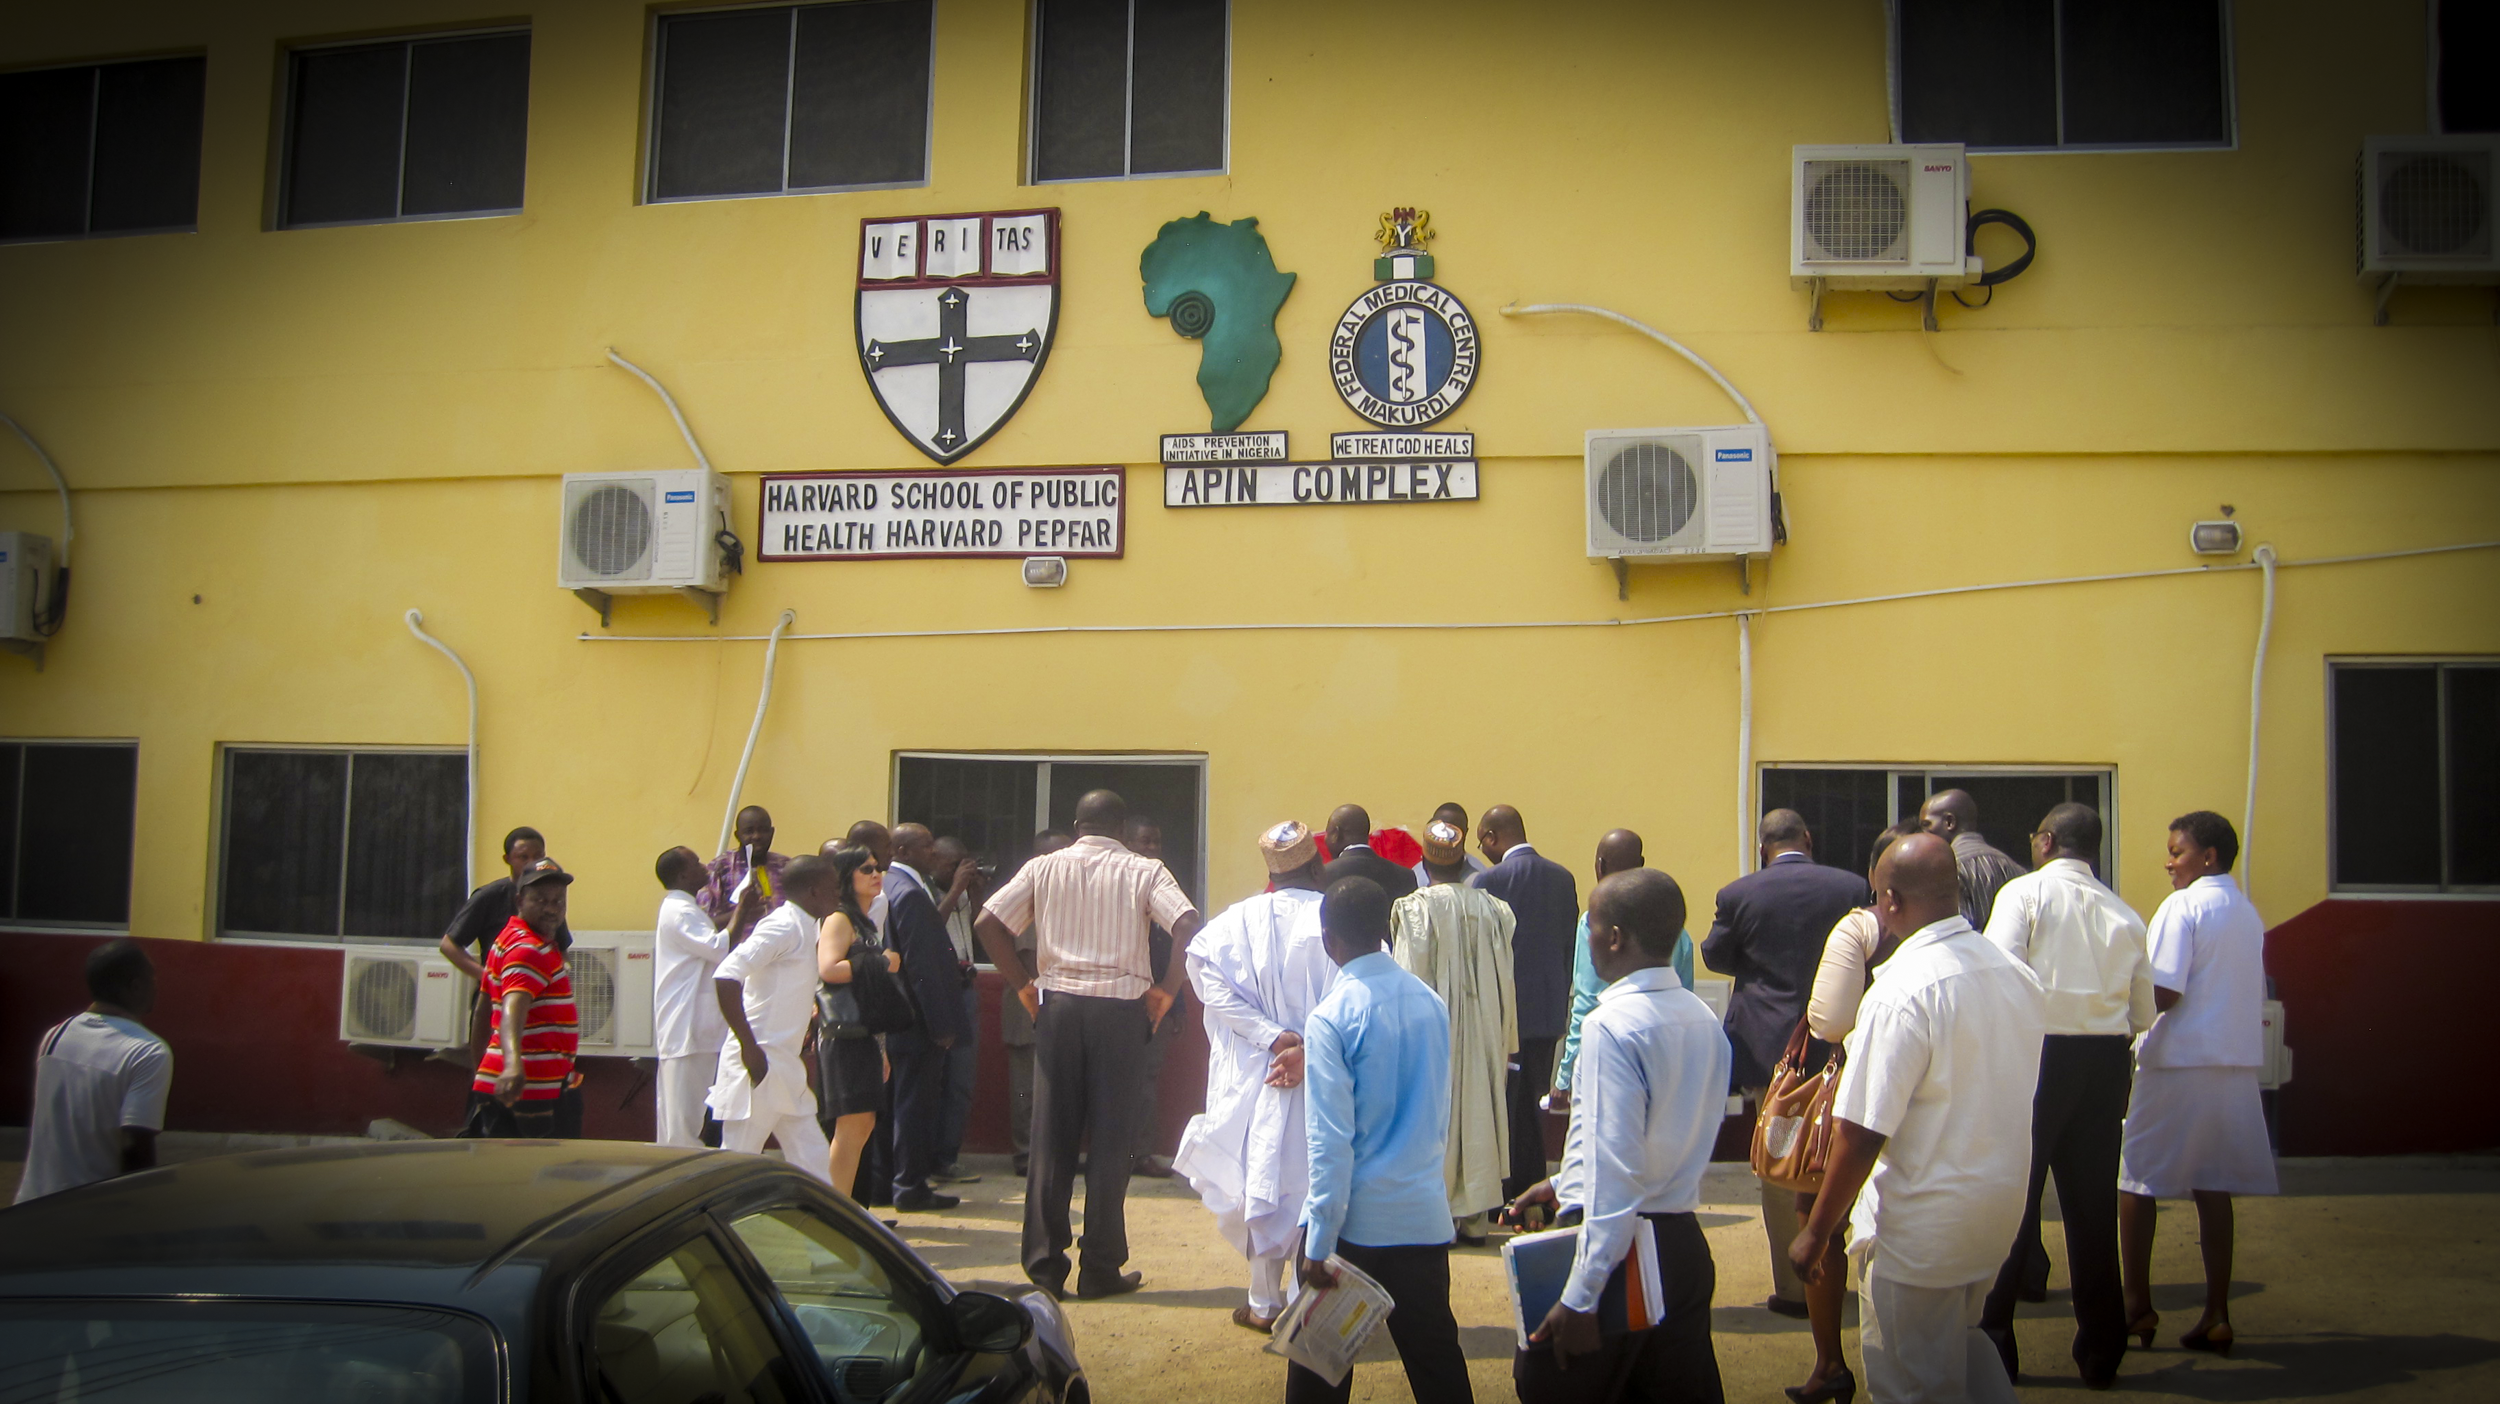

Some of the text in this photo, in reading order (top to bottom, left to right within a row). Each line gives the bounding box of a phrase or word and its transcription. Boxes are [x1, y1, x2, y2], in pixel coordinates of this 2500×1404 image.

[1923, 164, 1952, 172] SANYO
[1333, 284, 1474, 398] FEDERAL MEDICAL CENTRE
[1357, 392, 1451, 424] MAKURDI
[1166, 447, 1281, 461] INITIATIVE IN NIGERIA
[1172, 435, 1270, 449] AIDS PREVENTION
[1335, 437, 1469, 455] WE TREAT GOD HEALS
[1717, 451, 1750, 460] Panasonic
[767, 479, 1118, 513] HARVARD SCHOOL OF PUBLIC
[1181, 464, 1454, 504] APIN COMPLEX
[783, 518, 1112, 552] HEALTH HARVARD PEPFAR
